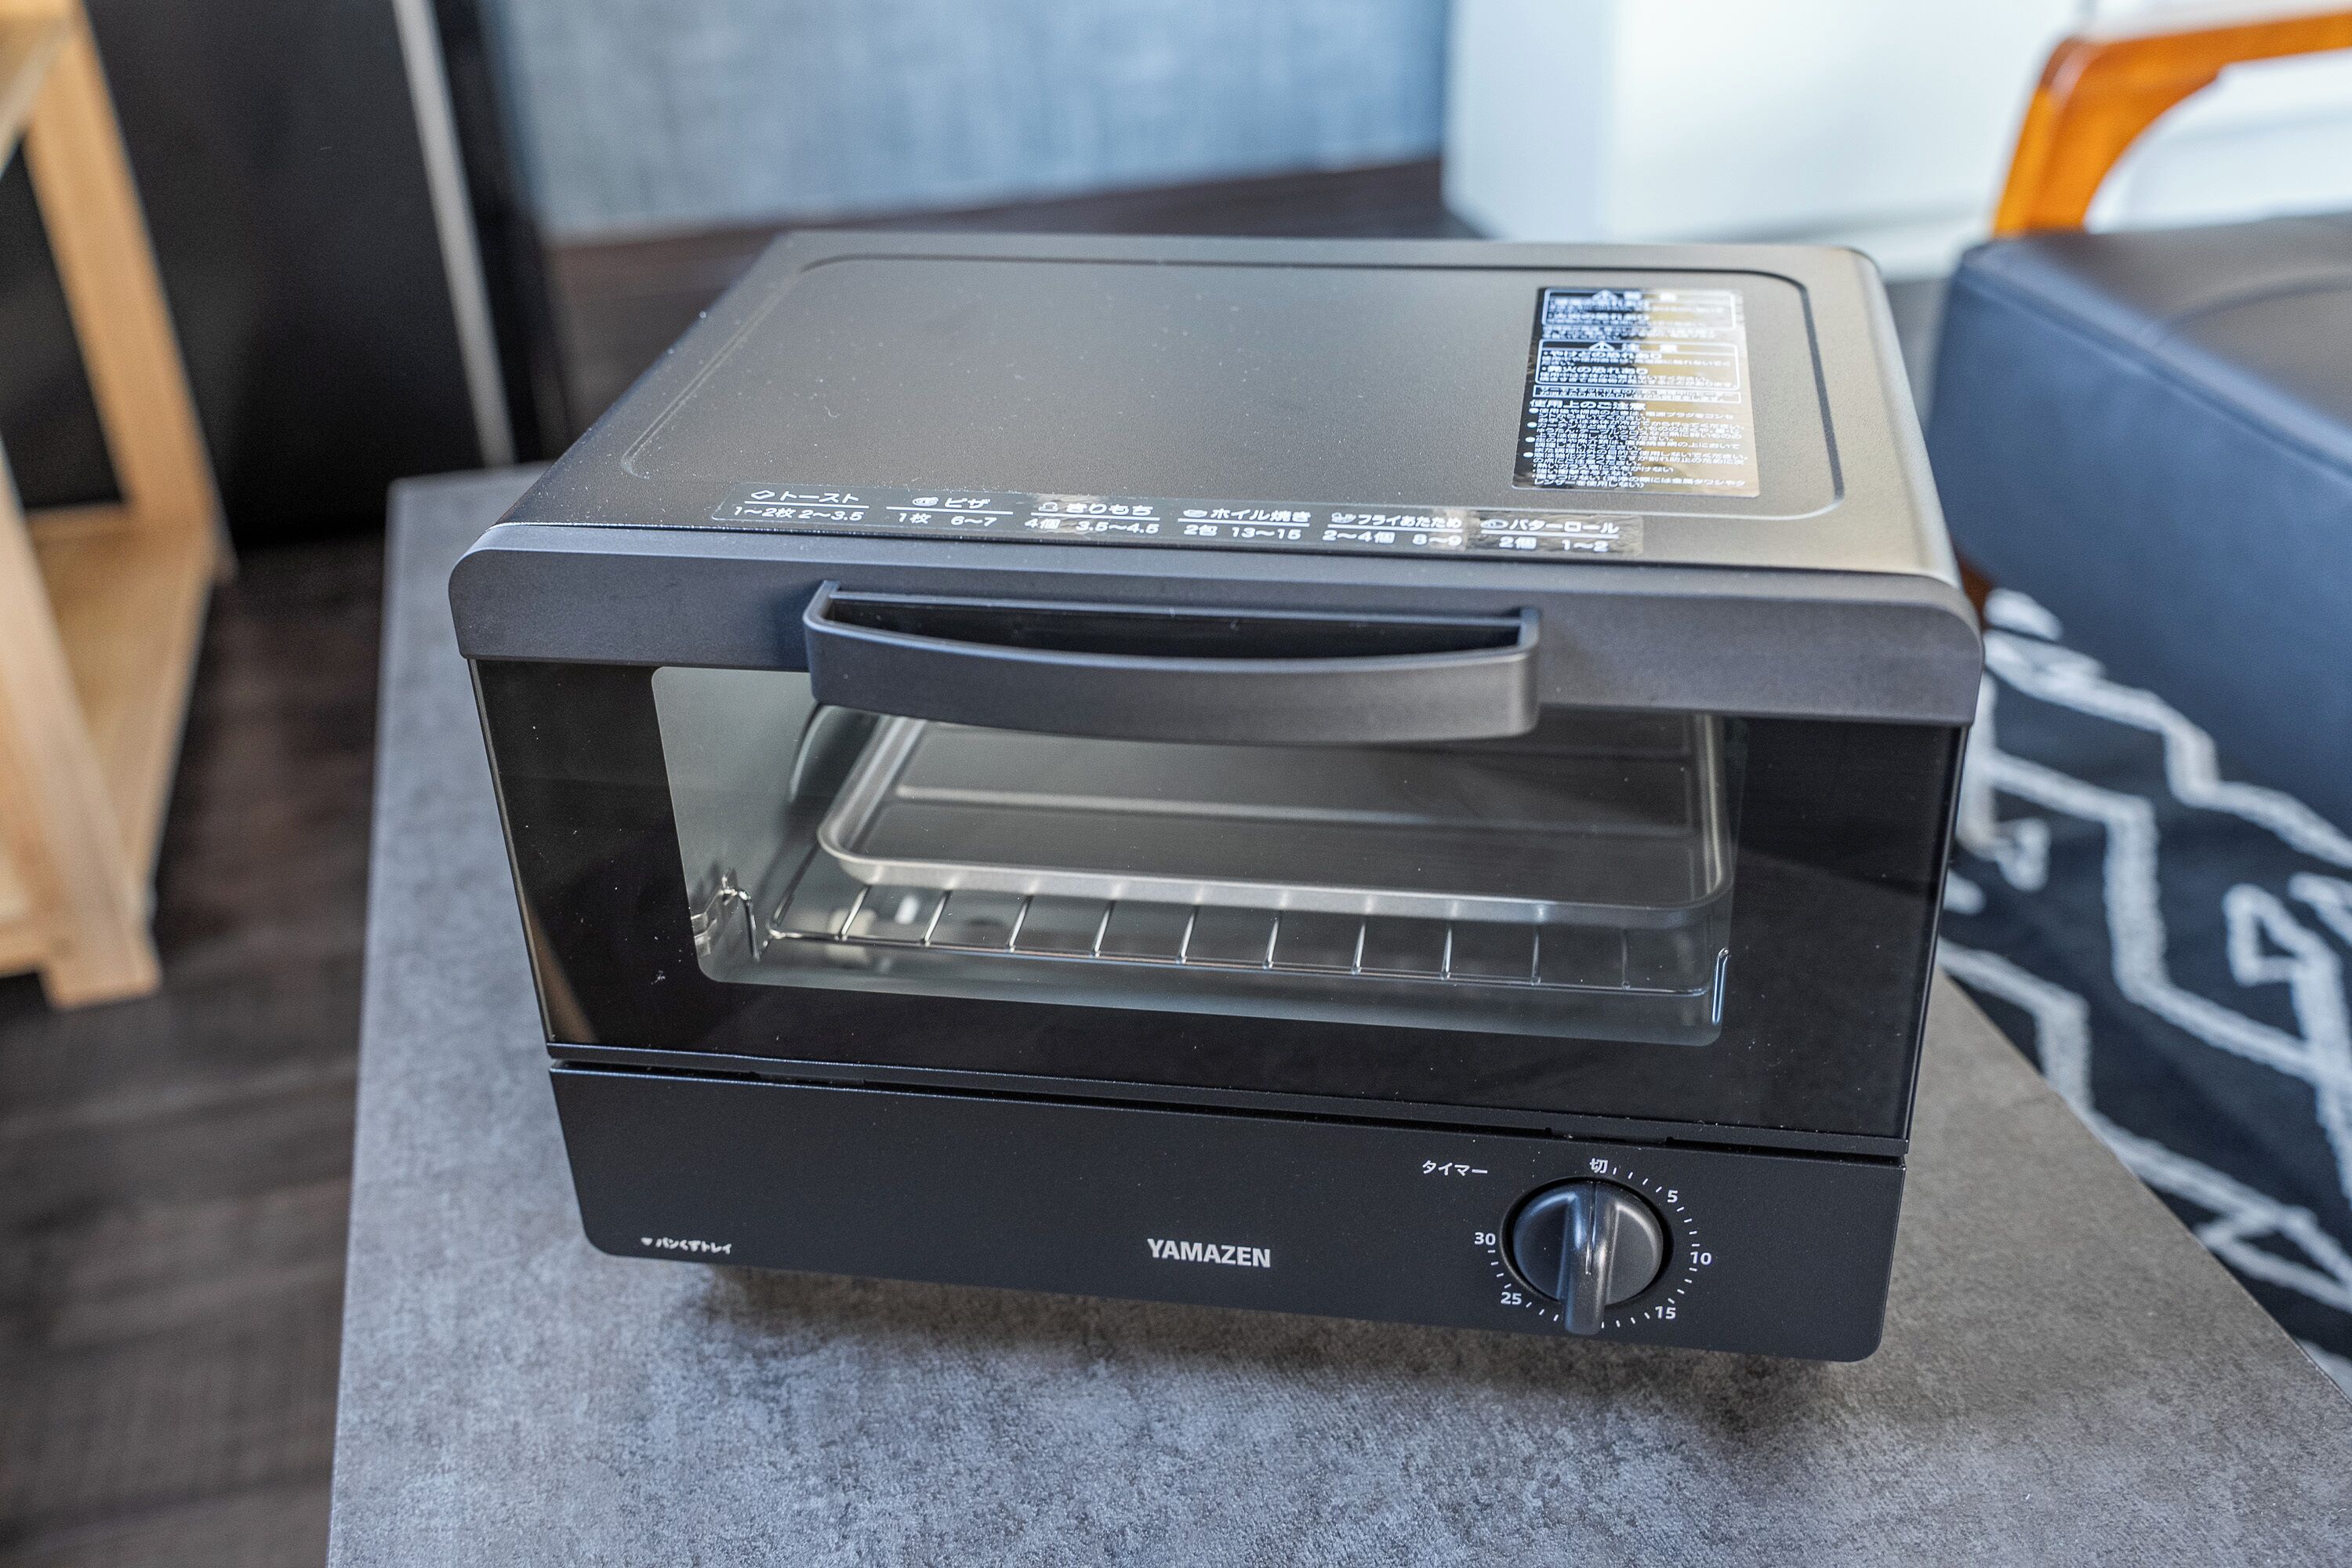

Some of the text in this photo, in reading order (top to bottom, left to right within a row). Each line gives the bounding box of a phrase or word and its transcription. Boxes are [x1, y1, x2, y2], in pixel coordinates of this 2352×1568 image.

[779, 491, 860, 504] トースト
[945, 496, 991, 510] ピザ
[1066, 503, 1153, 517] きりもち
[1508, 518, 1620, 535] バターロール
[1421, 1160, 1488, 1175] タイマー
[1589, 1158, 1609, 1174] 切
[1668, 1190, 1679, 1203] 5
[1474, 1232, 1496, 1246] 30
[1147, 1238, 1271, 1269] YAMAZEN
[1690, 1251, 1711, 1265] 10
[1501, 1291, 1523, 1305] 25
[1654, 1306, 1676, 1319] 15
